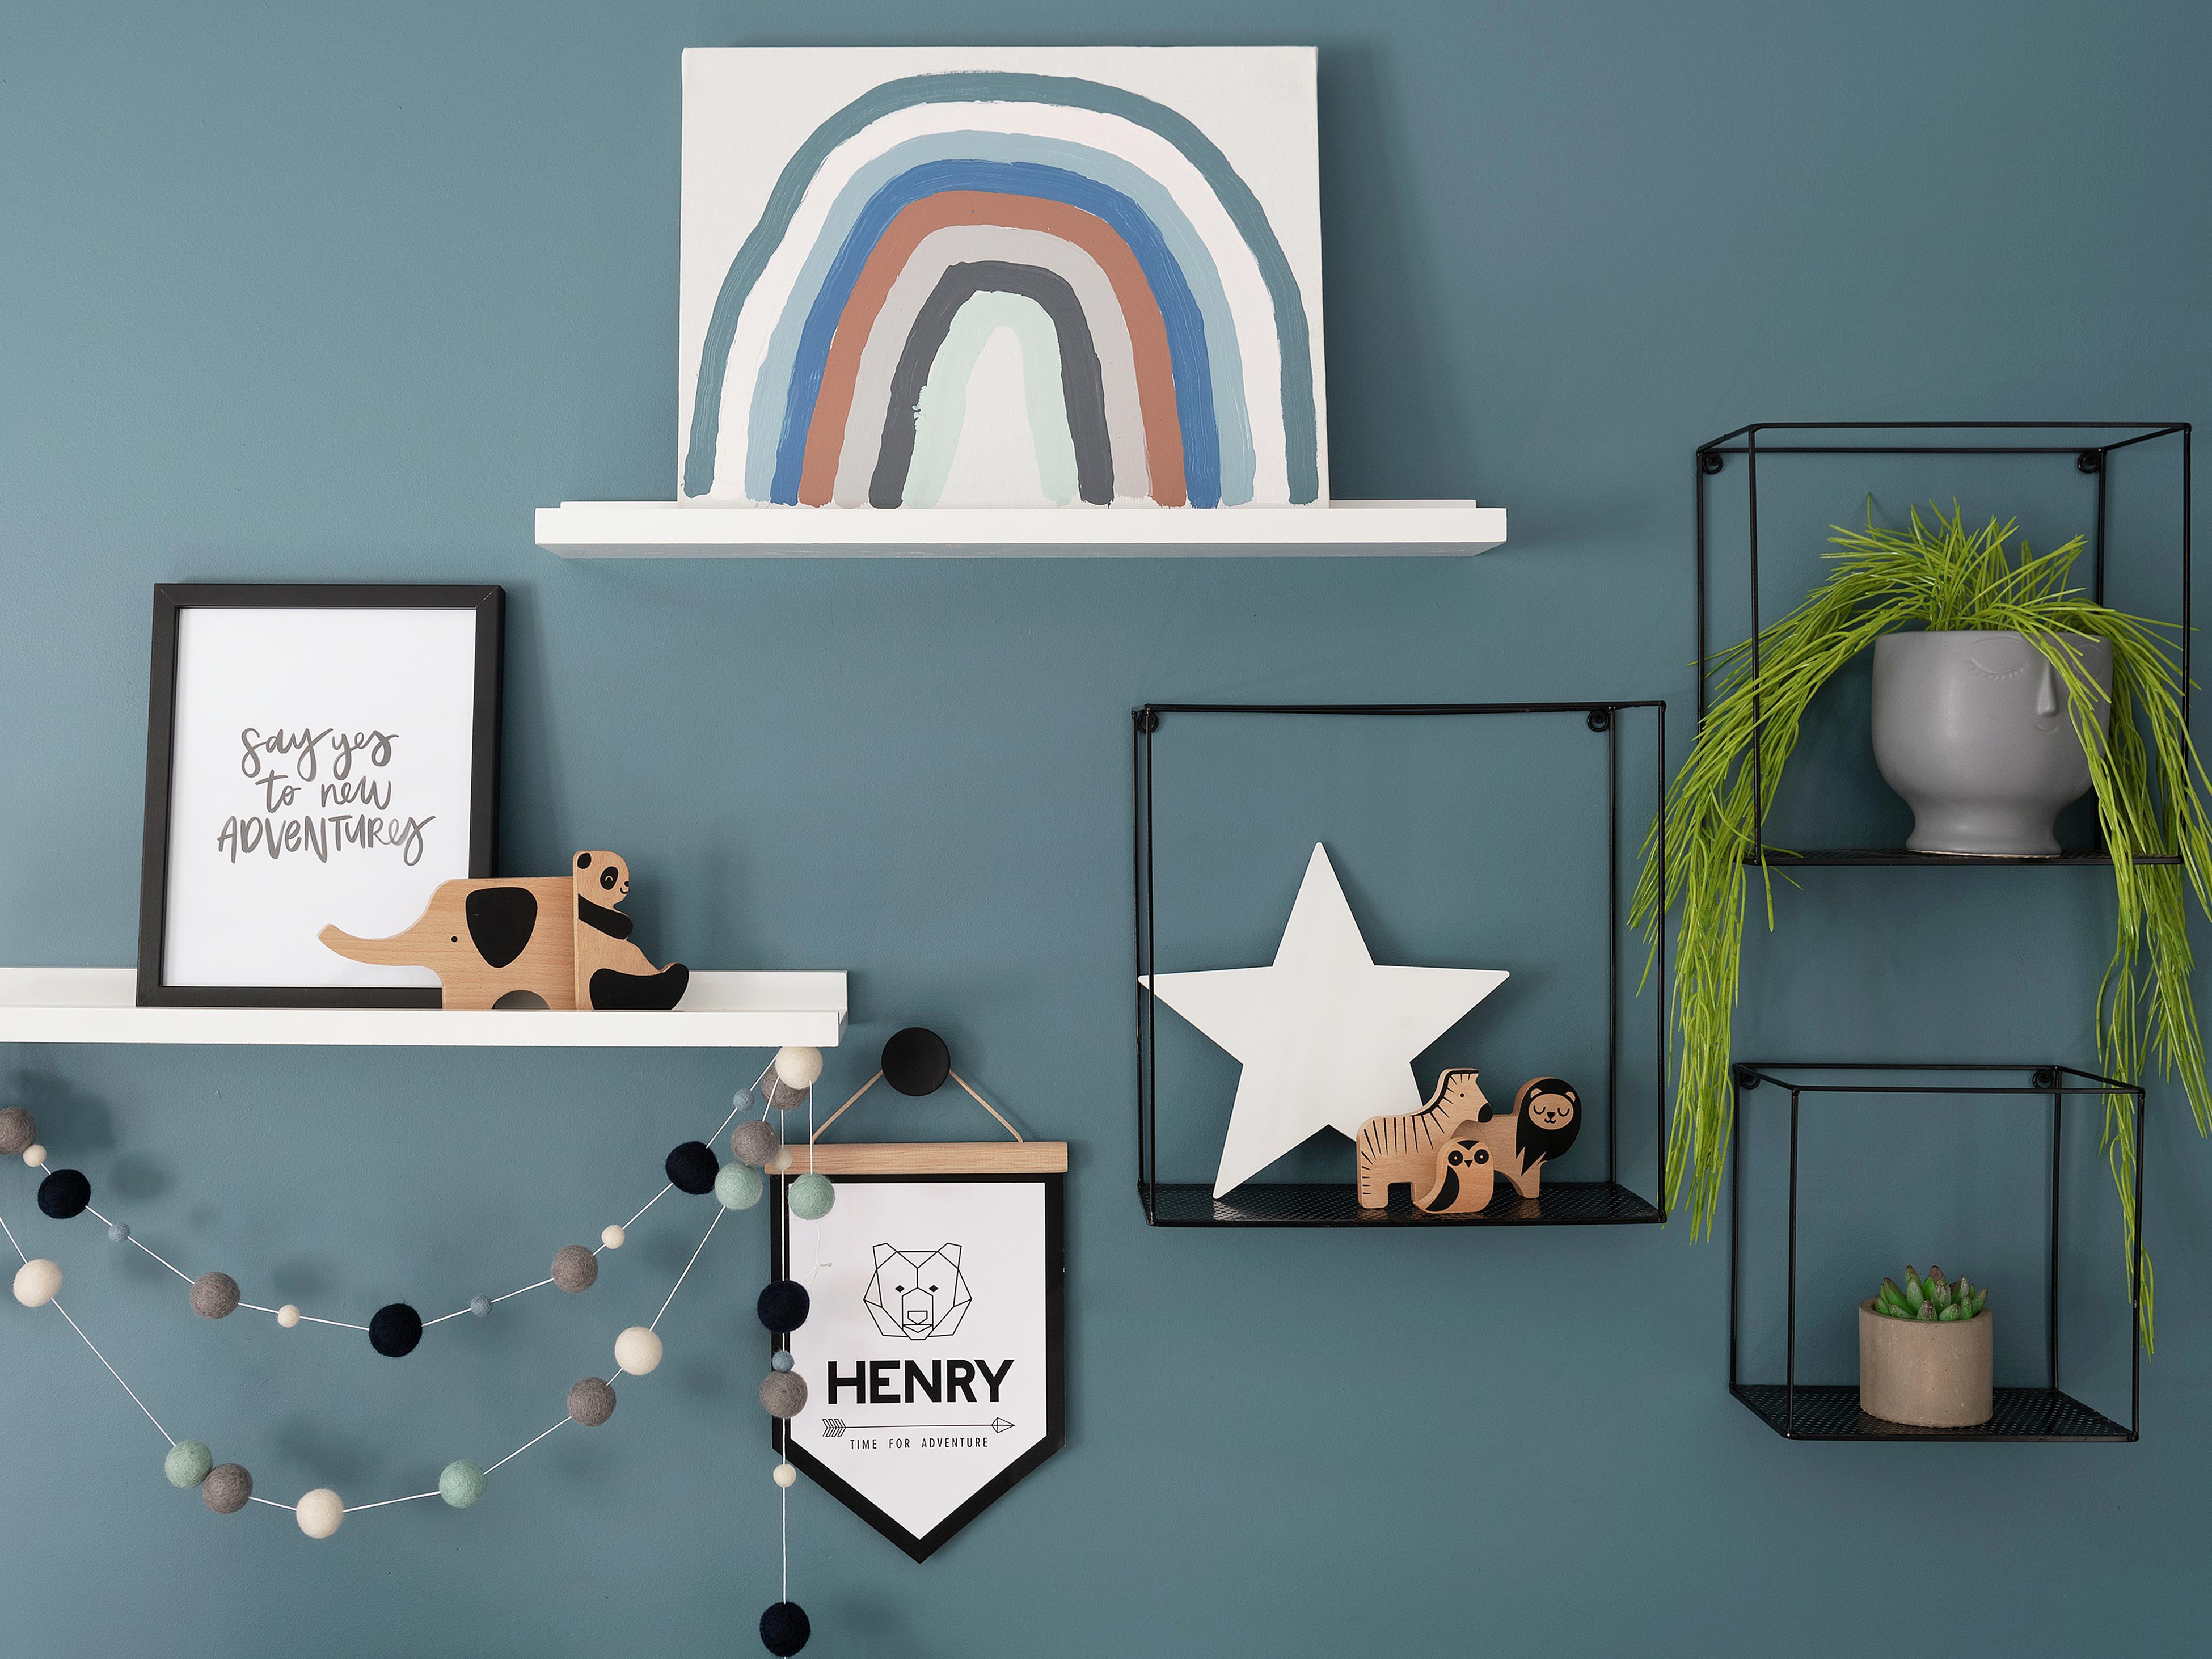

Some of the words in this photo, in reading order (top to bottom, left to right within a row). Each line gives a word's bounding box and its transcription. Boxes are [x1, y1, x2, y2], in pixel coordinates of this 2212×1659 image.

[331, 729, 400, 781] yes
[255, 769, 302, 814] to
[320, 775, 392, 810] new
[828, 1359, 1015, 1405] HENRY
[850, 1438, 877, 1450] TIME
[889, 1438, 910, 1449] FOR
[921, 1437, 988, 1448] ADVENTURE
